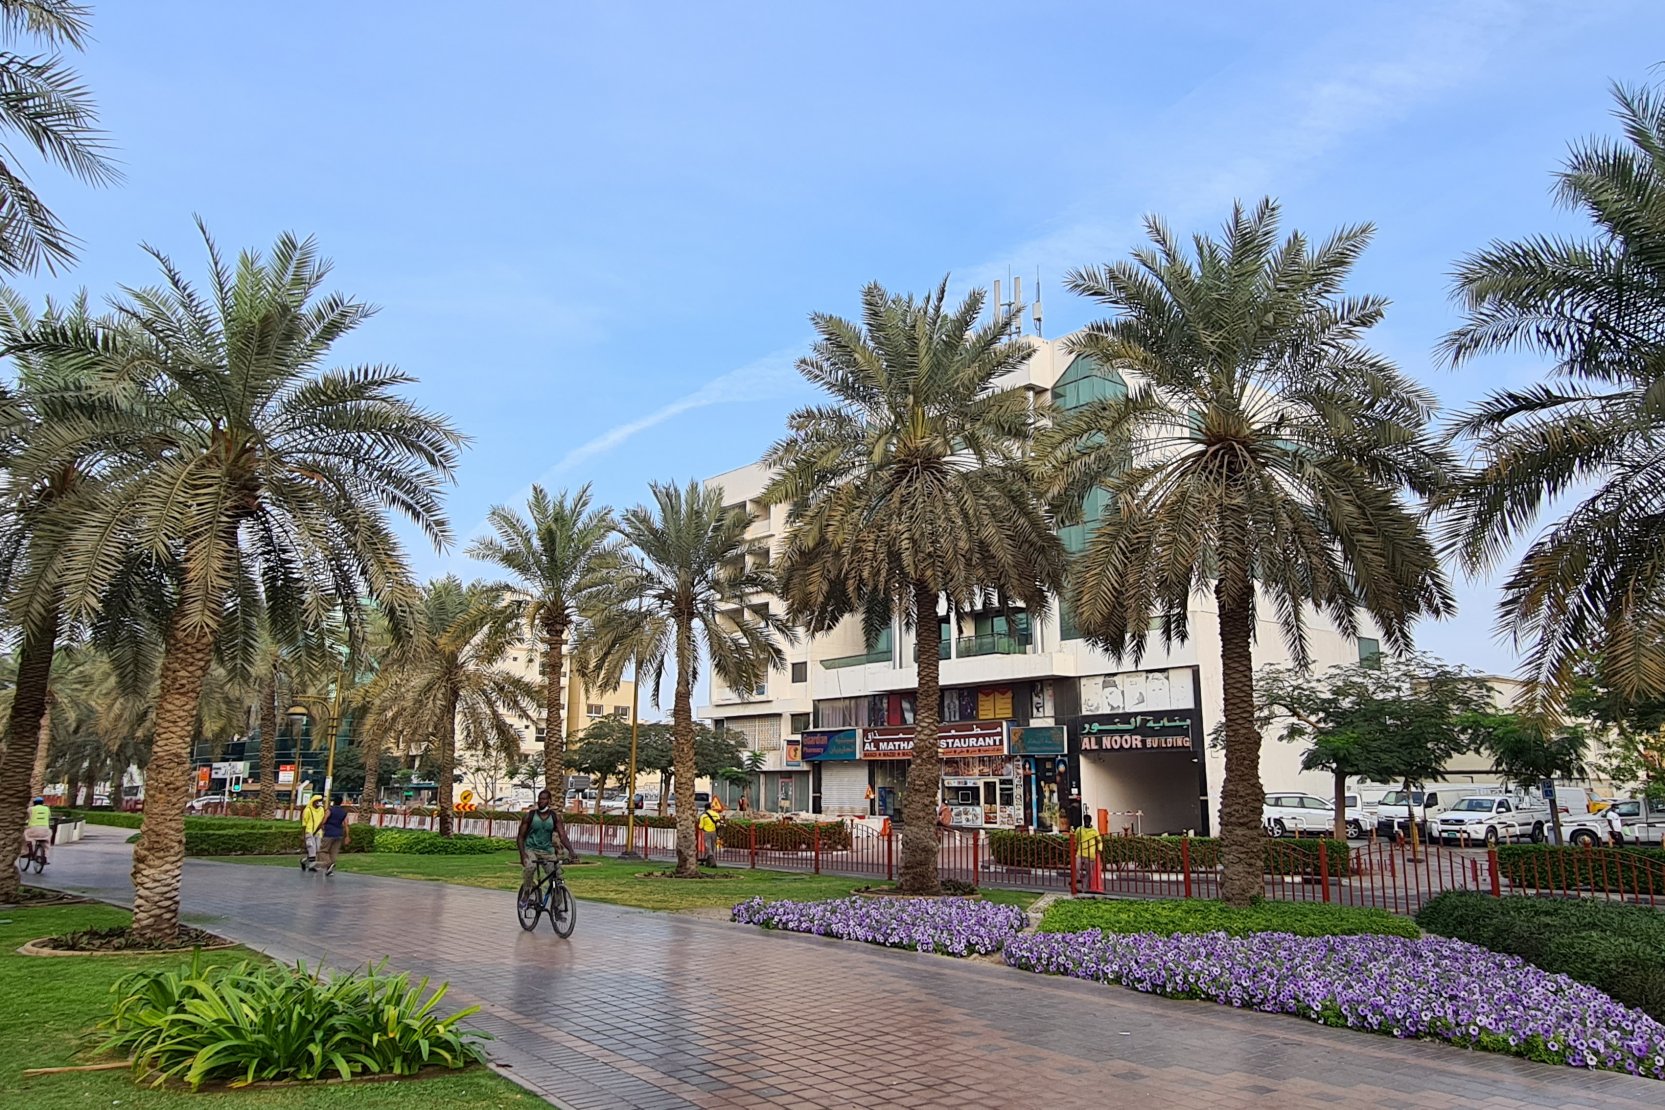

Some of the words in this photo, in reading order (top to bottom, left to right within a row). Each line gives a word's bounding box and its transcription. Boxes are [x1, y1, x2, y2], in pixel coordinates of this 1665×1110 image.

[1081, 715, 1142, 734] النور
[864, 742, 877, 751] AL
[879, 741, 915, 750] MATHA
[938, 736, 1002, 748] STAURANT
[1081, 737, 1099, 750] AL
[1102, 735, 1143, 749] NOOR
[1146, 737, 1190, 747] BUILDING
